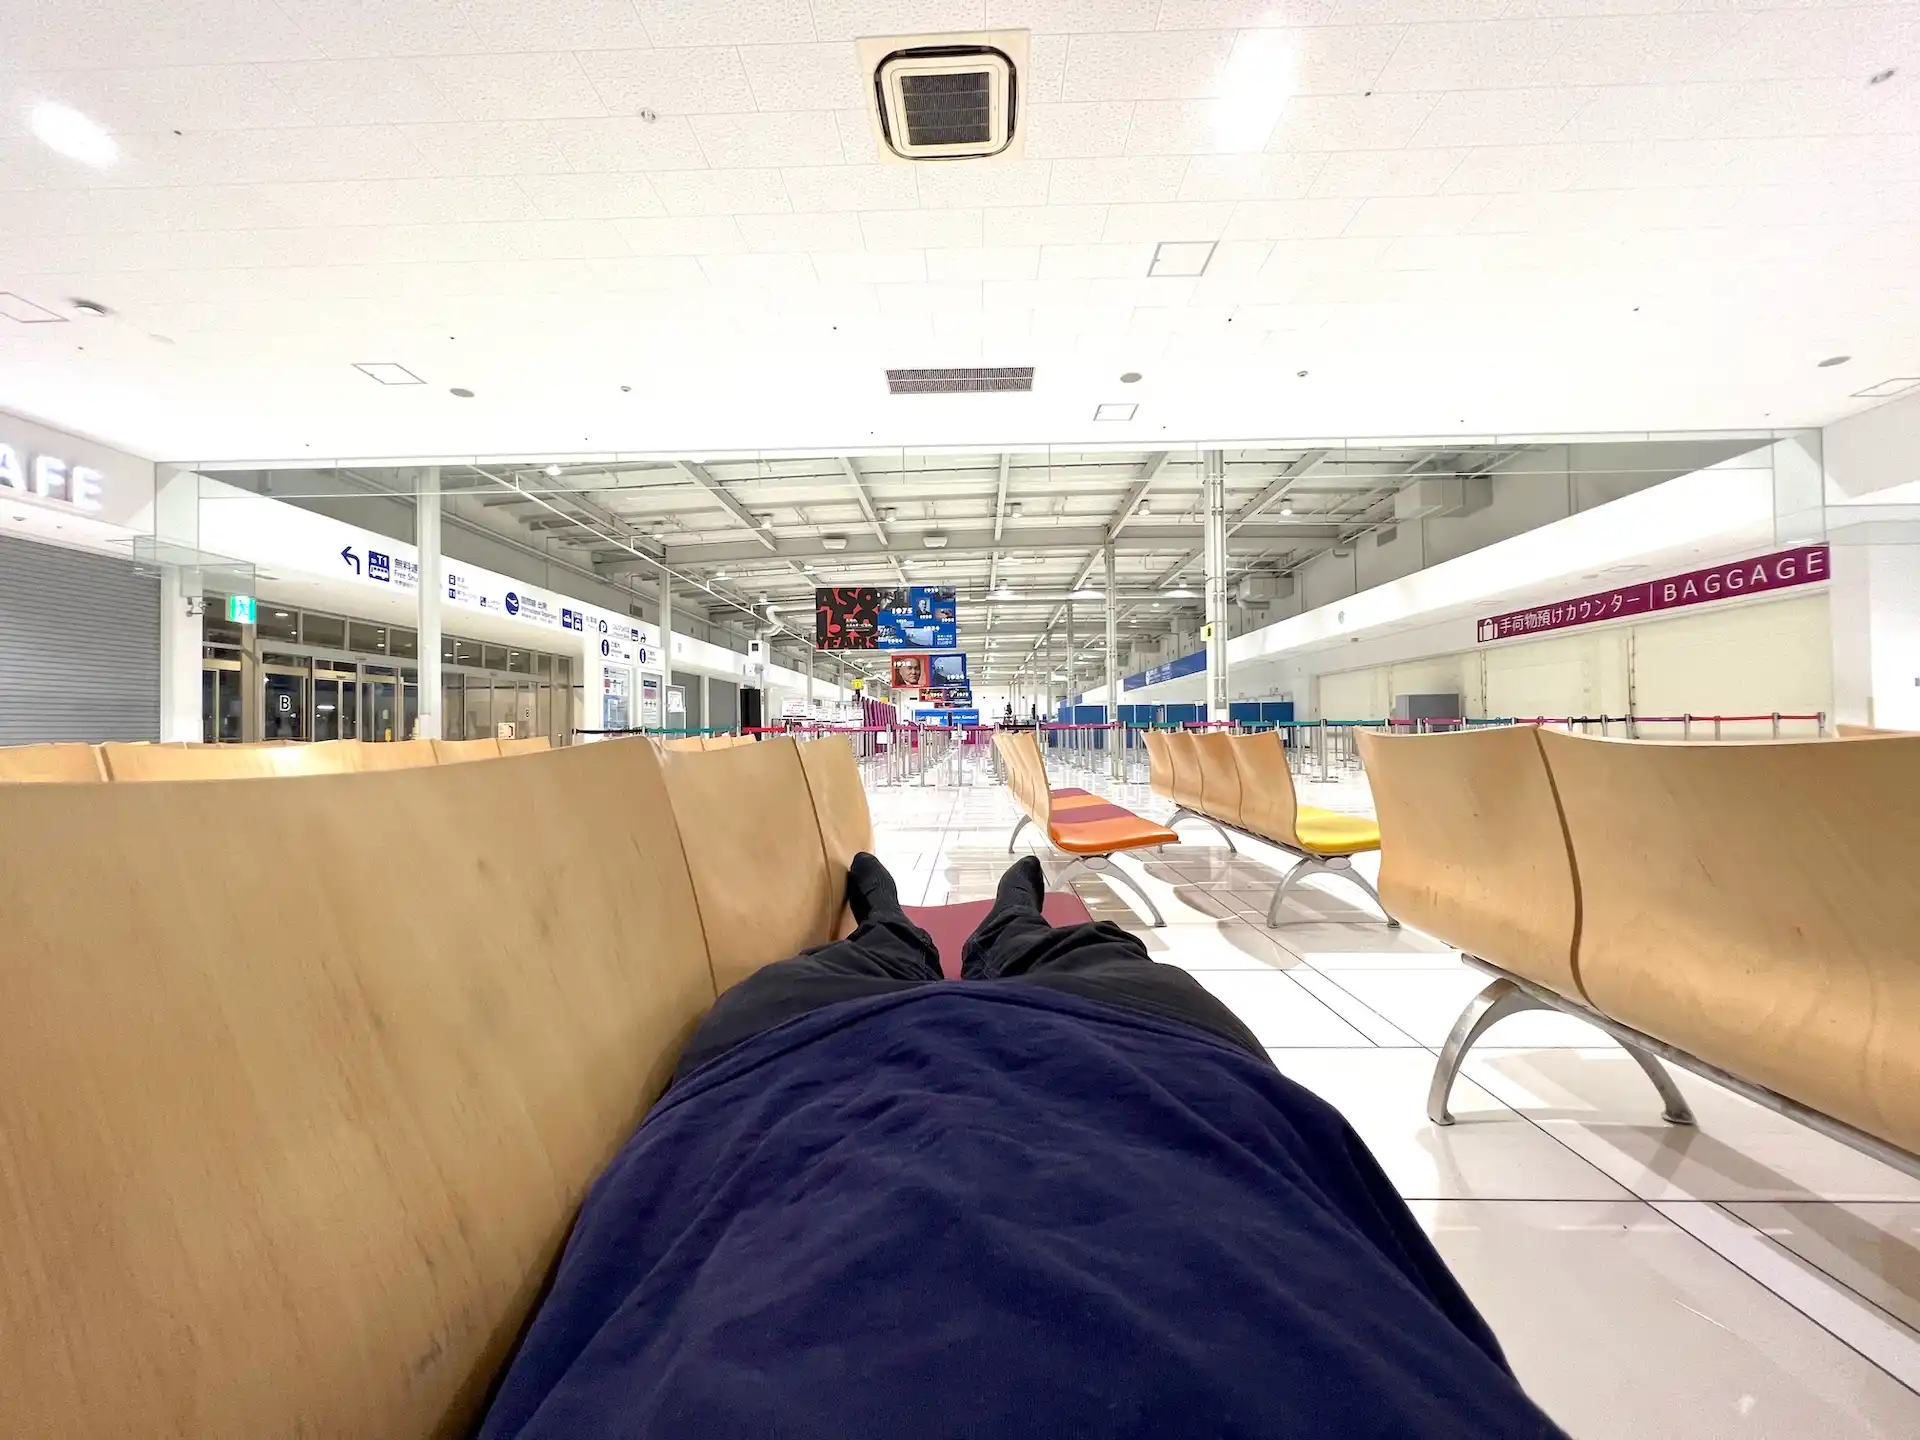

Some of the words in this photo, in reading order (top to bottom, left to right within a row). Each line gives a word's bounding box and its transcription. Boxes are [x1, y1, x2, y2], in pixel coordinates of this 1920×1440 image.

[377, 555, 387, 567] T1
[1663, 551, 1824, 602] BAGGAGE
[891, 607, 913, 615] 1975
[1499, 596, 1640, 634] 手荷物預けカウンター
[279, 694, 291, 712] B
